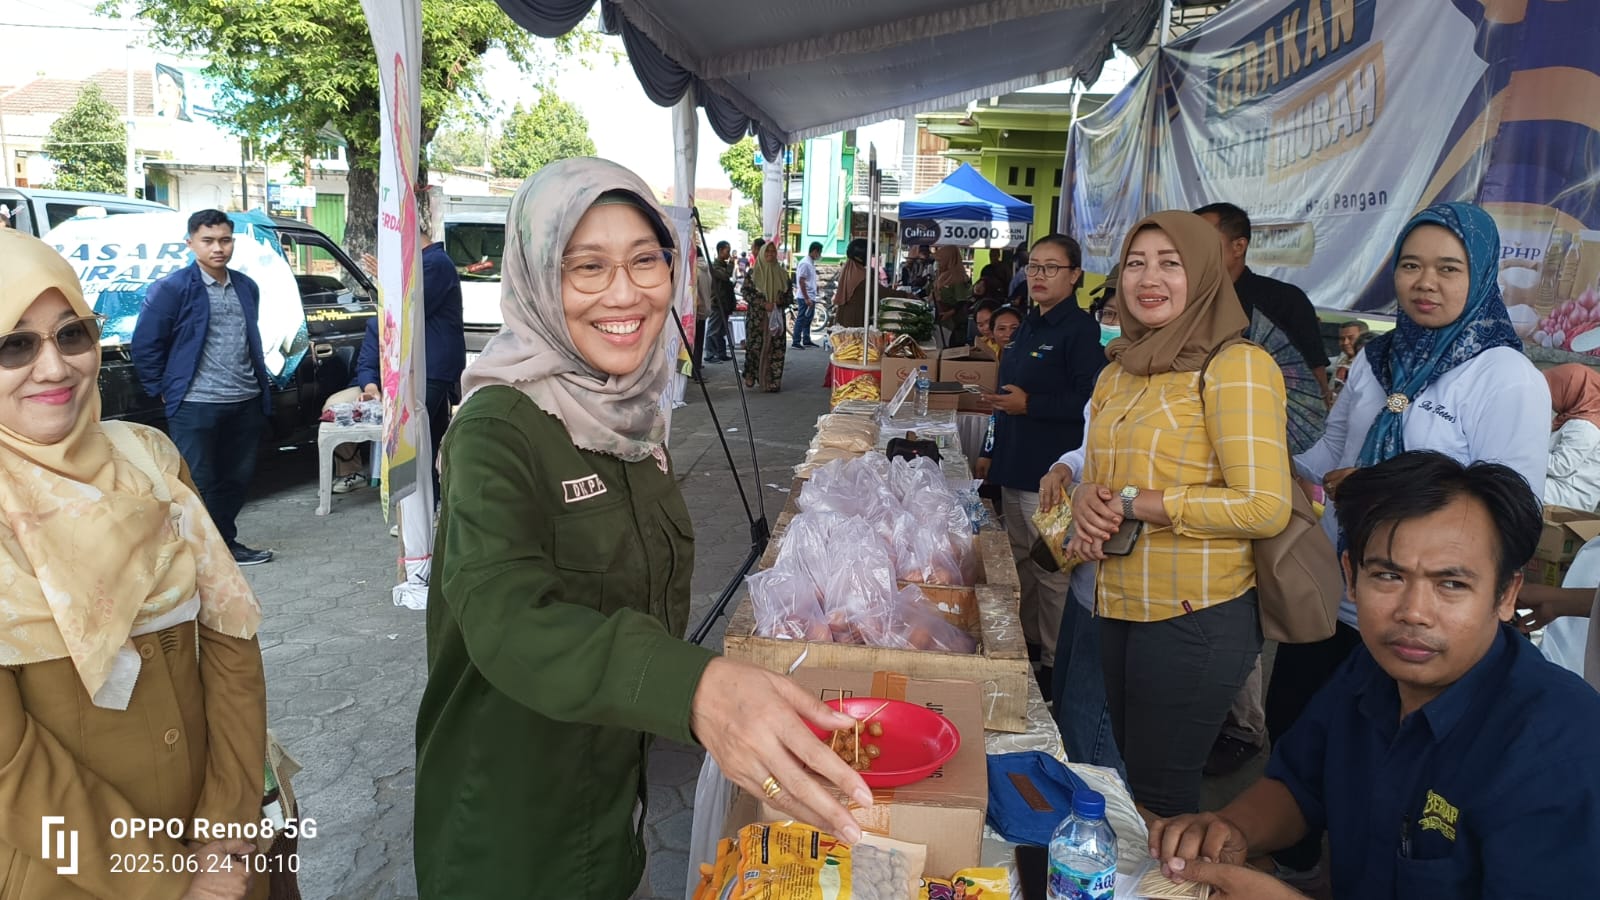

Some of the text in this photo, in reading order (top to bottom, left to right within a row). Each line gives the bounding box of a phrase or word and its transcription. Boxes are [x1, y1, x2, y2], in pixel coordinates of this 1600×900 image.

[1271, 62, 1377, 172] MURAH
[1333, 190, 1387, 212] Pangan
[943, 226, 999, 241] 30.000
[1501, 245, 1541, 261] PHP
[80, 264, 182, 281] RAH
